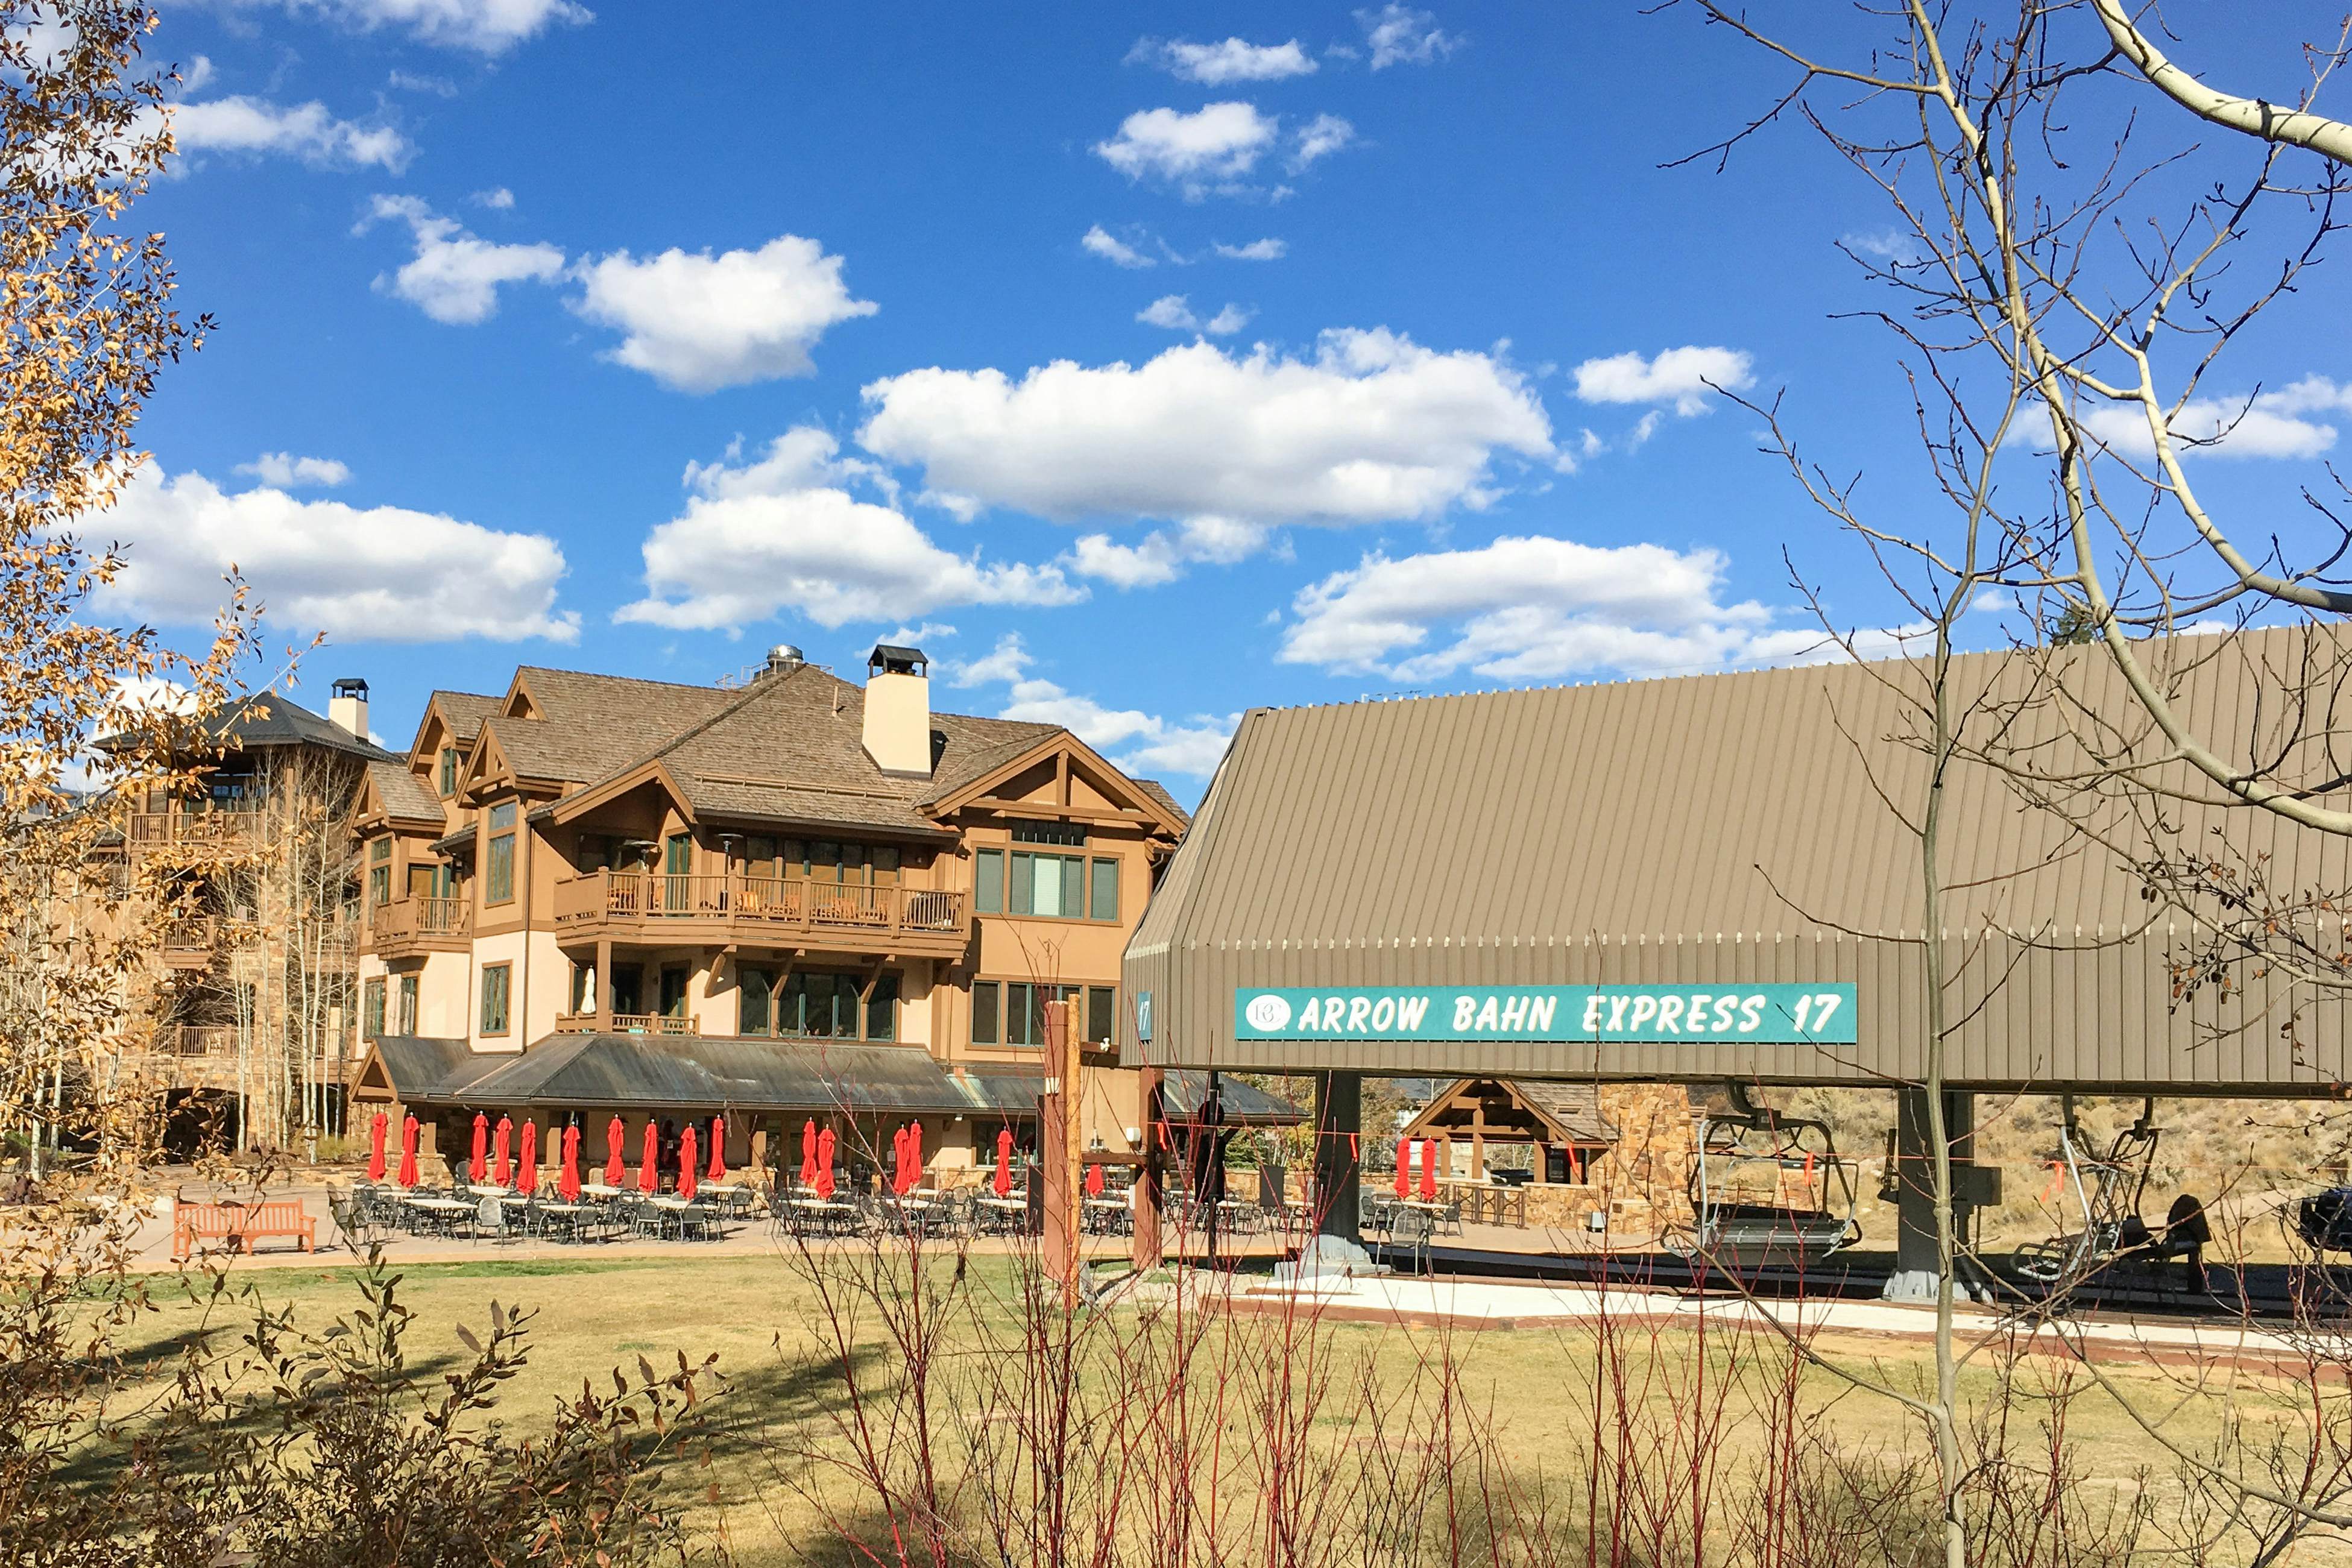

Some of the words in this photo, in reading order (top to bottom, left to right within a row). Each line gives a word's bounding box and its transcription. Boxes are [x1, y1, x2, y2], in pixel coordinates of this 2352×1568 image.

[1138, 1001, 1150, 1031] 17
[1297, 997, 1430, 1033] ARROW
[1452, 995, 1558, 1032] BAHN
[1582, 995, 1767, 1034] EXPRESS
[1794, 995, 1843, 1033] 17
